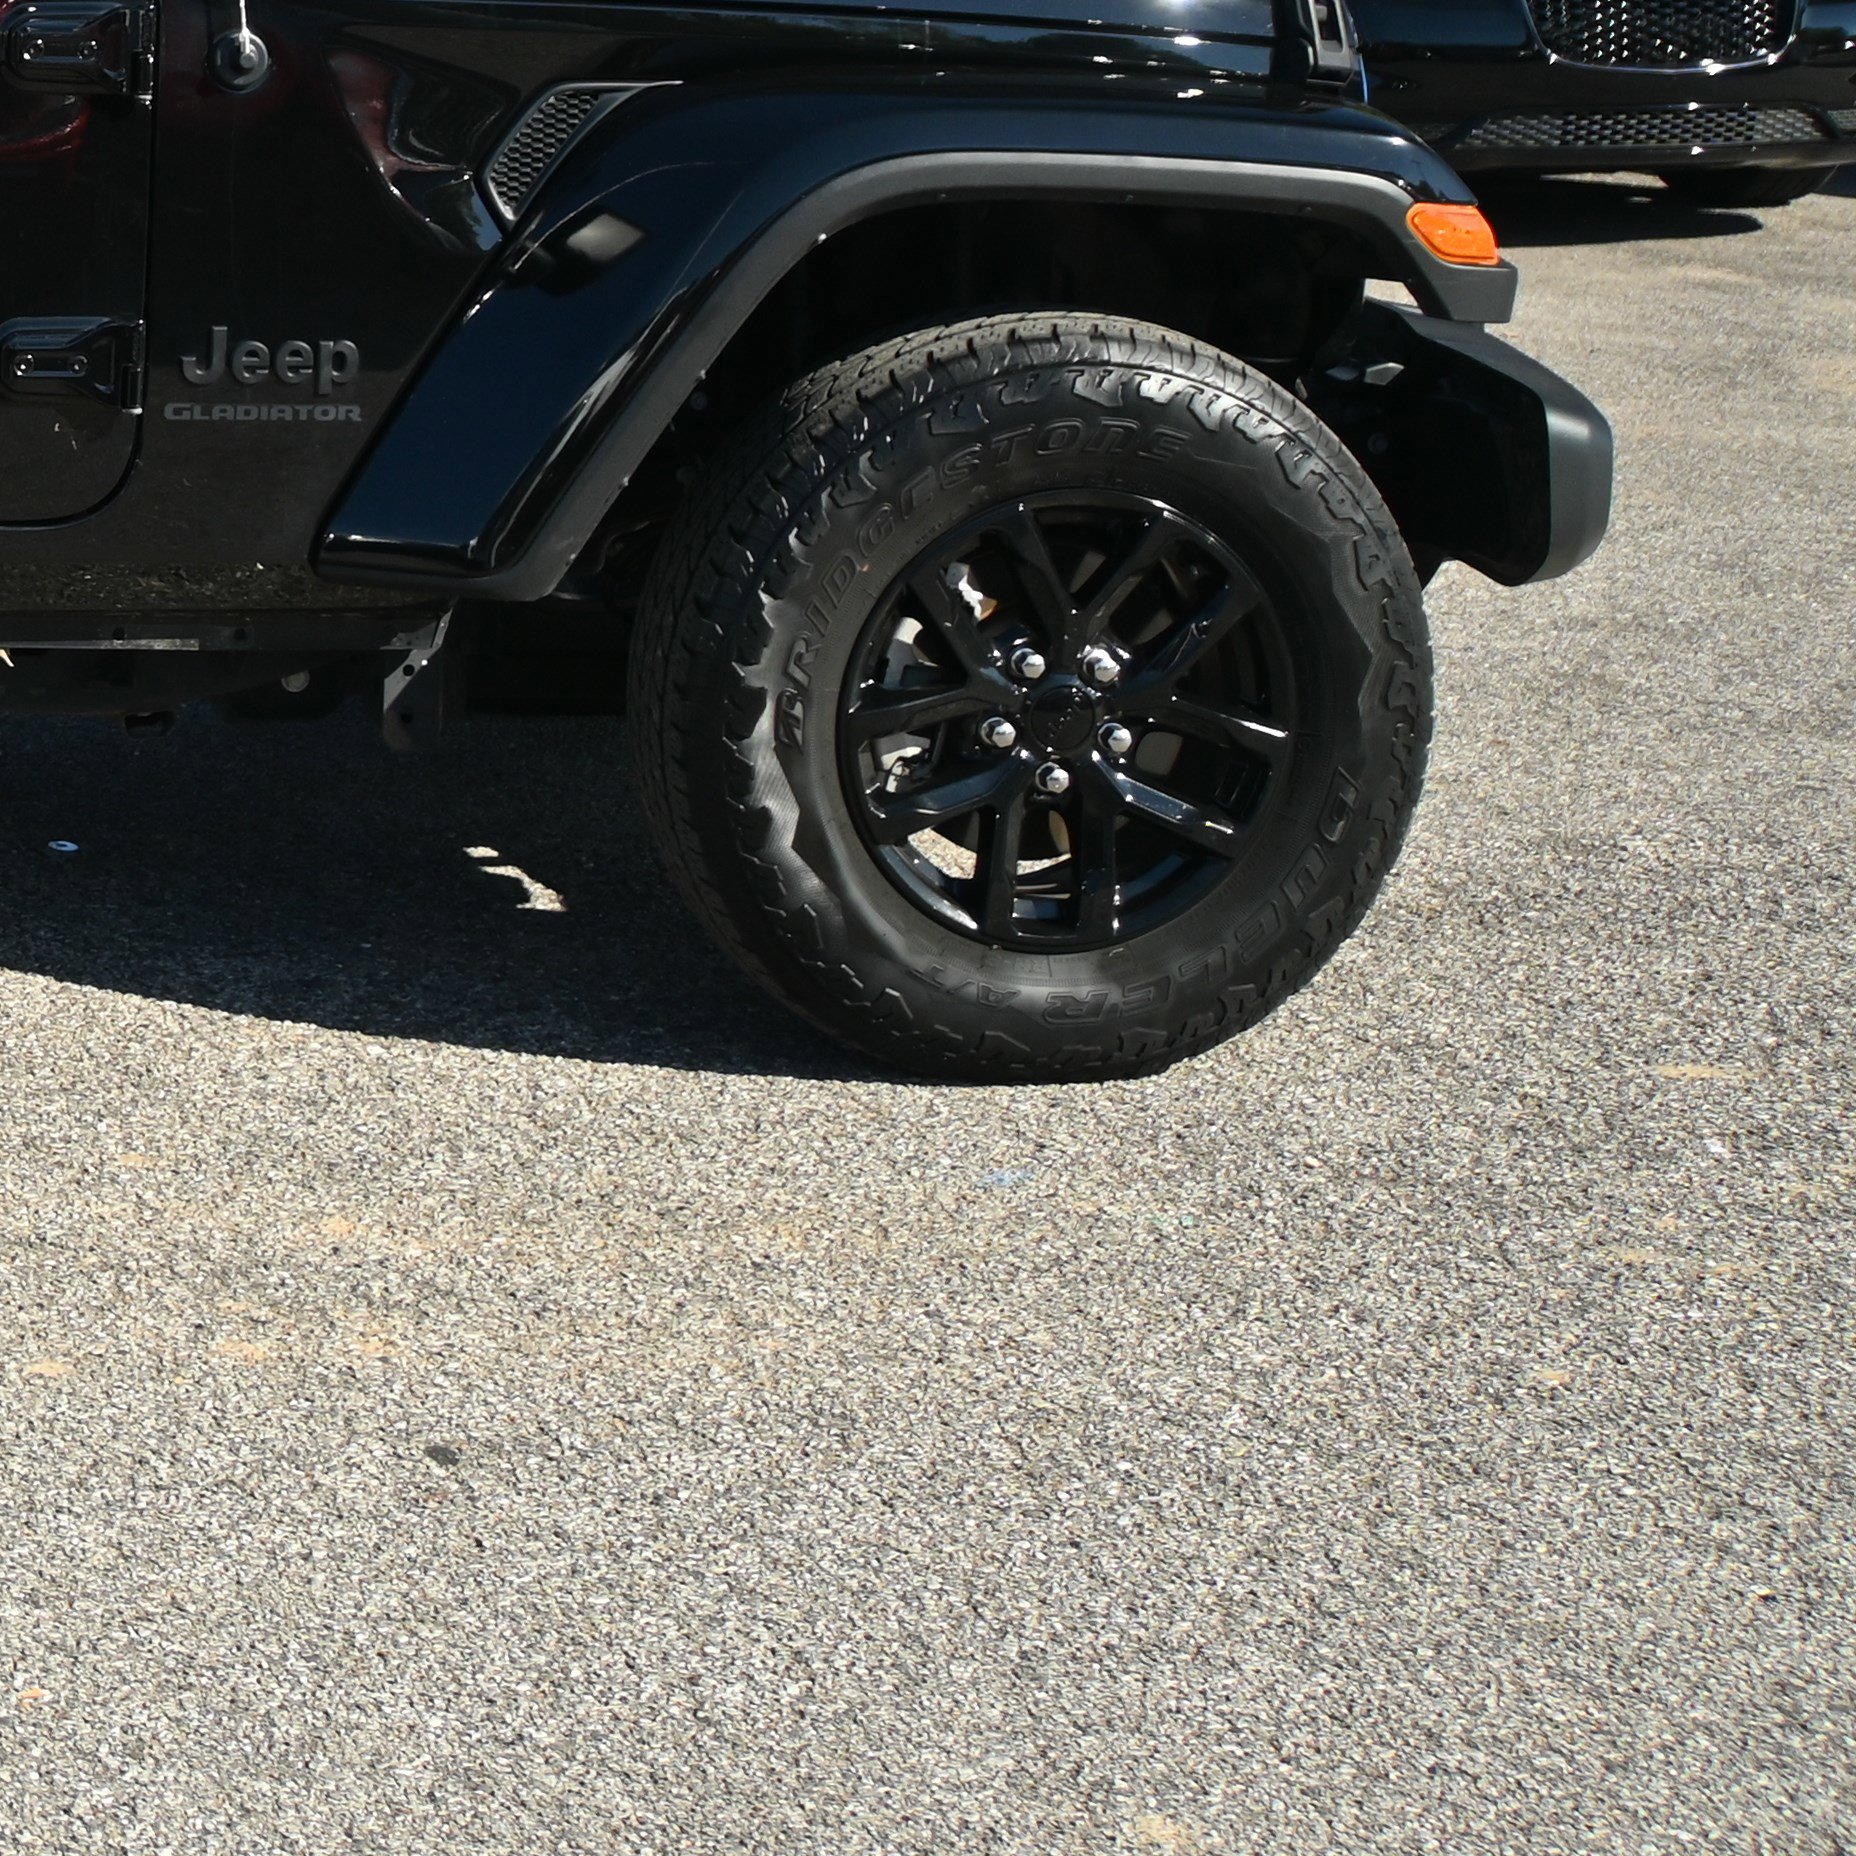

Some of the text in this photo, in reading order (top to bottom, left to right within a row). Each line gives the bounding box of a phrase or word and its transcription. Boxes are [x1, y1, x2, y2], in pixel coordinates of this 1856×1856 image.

[164, 402, 362, 422] GLADIATOR
[181, 325, 360, 395] Jeep
[774, 417, 1194, 747] BRIDGESTONE
[909, 766, 1360, 1026] DUELER A/T
